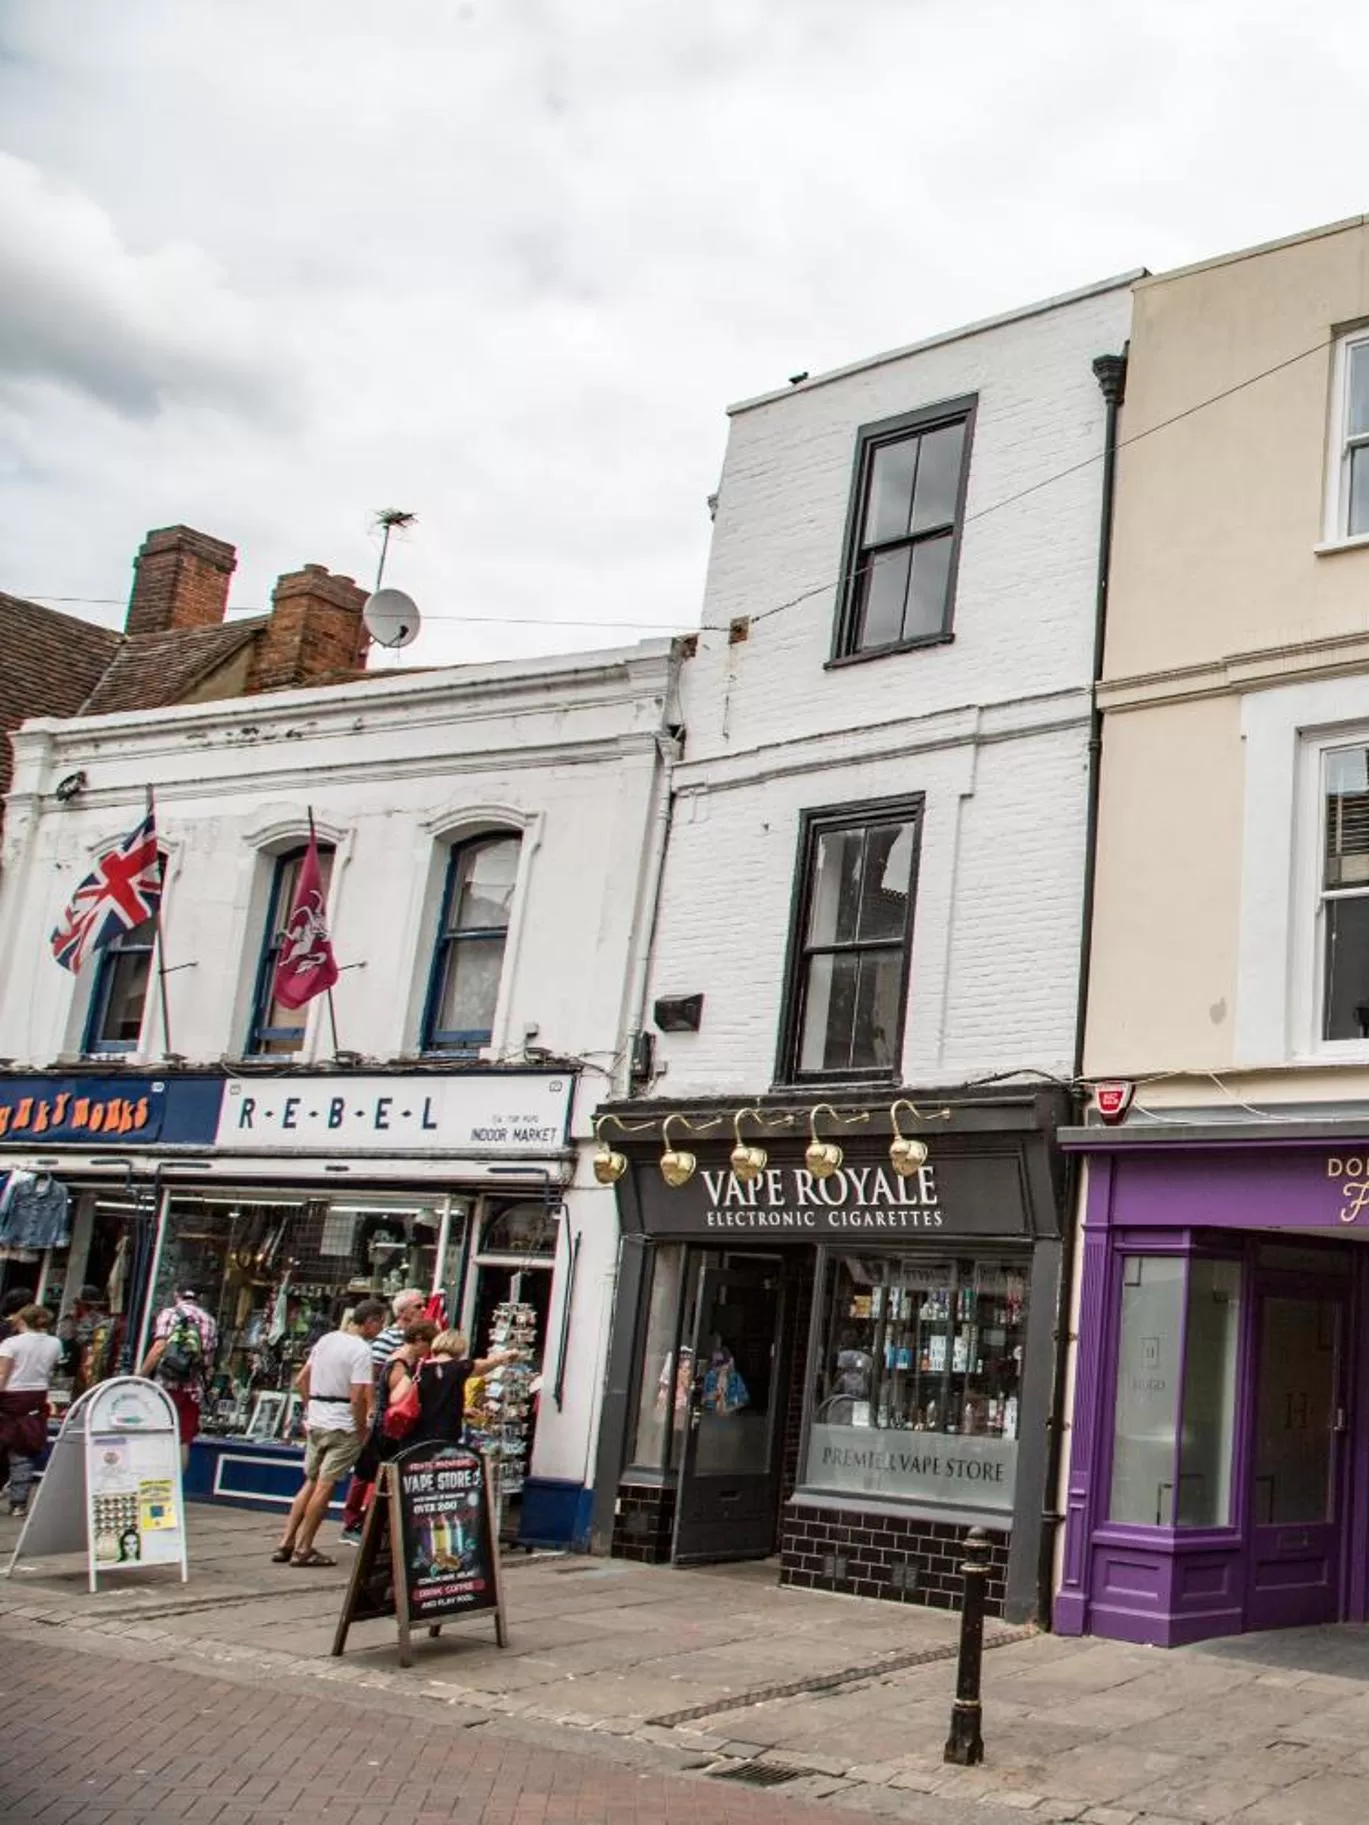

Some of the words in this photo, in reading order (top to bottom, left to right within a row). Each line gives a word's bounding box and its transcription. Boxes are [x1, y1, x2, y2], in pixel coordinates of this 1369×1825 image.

[471, 1127, 508, 1142] INDOOR
[513, 1127, 557, 1142] MARKET
[700, 1168, 785, 1207] VAPE
[792, 1166, 938, 1206] ROYALE
[707, 1211, 816, 1227] ELECTRONIC
[828, 1211, 943, 1227] CIGARETTES
[899, 1453, 941, 1476] VAPE
[944, 1458, 1006, 1483] STORE
[403, 1473, 433, 1494] VAPE
[437, 1470, 472, 1490] STORE
